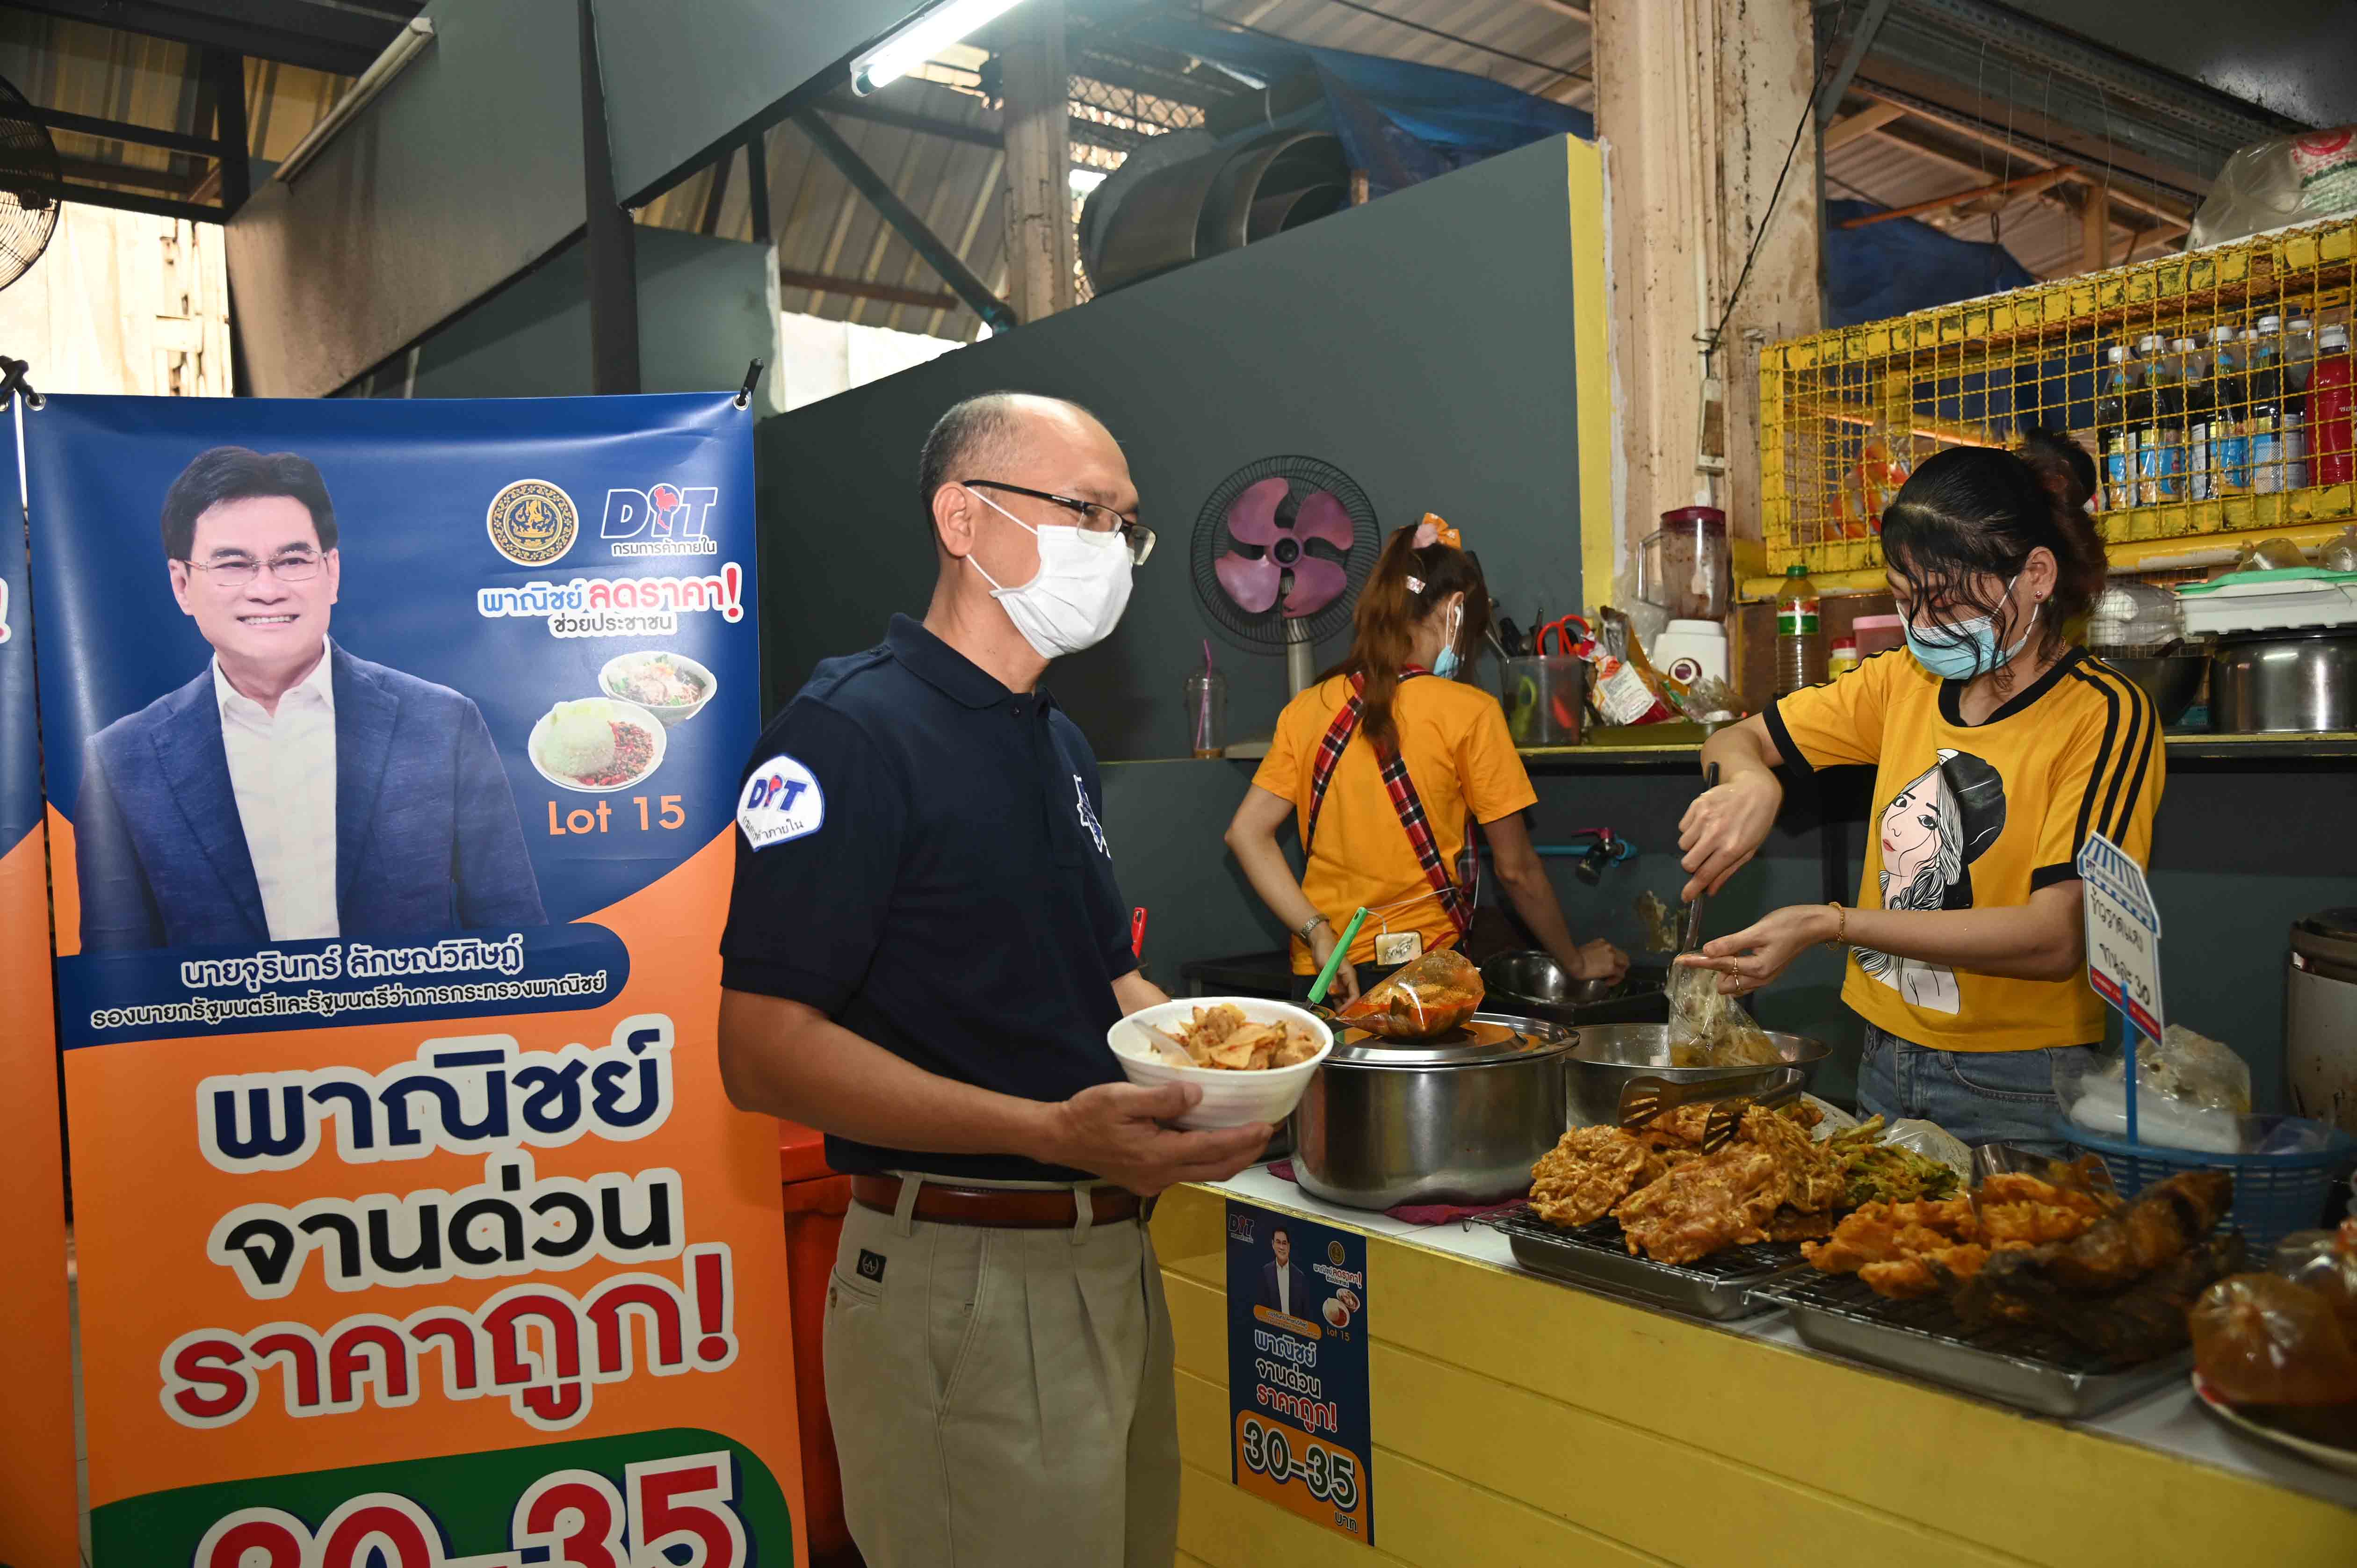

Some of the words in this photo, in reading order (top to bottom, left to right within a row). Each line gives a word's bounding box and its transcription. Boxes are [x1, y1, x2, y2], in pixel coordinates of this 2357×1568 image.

[601, 483, 718, 538] DIT
[613, 537, 715, 555] กรมการค้าภายใน
[483, 584, 582, 612] พาณิชย์
[589, 567, 739, 617] ลดราคา!
[554, 613, 672, 633] ช่วยประชาชน
[548, 800, 612, 835] Lot
[633, 795, 686, 831] 15
[185, 945, 339, 989] นายจุรินทร์
[351, 936, 521, 973] ลักษณวิศิษฏ์
[94, 973, 605, 1026] รองนายกรัฐมนตรีและรัฐมนตรีว่าการกระทรวงพาณิชย์
[2135, 975, 2150, 1005] 30
[213, 1029, 660, 1159] พาณิชย์
[224, 1164, 671, 1285] จานด่วน
[1332, 1268, 1362, 1289] ลดราคา!
[174, 1253, 729, 1421] ราคาถูก!
[1255, 1330, 1316, 1367] พาณิชย์
[1341, 1330, 1350, 1342] 15
[1256, 1358, 1321, 1399] จานด่วน
[1257, 1384, 1338, 1433] ราคาถูก!
[1244, 1418, 1357, 1508] 30-35
[1334, 1511, 1359, 1533] บาท
